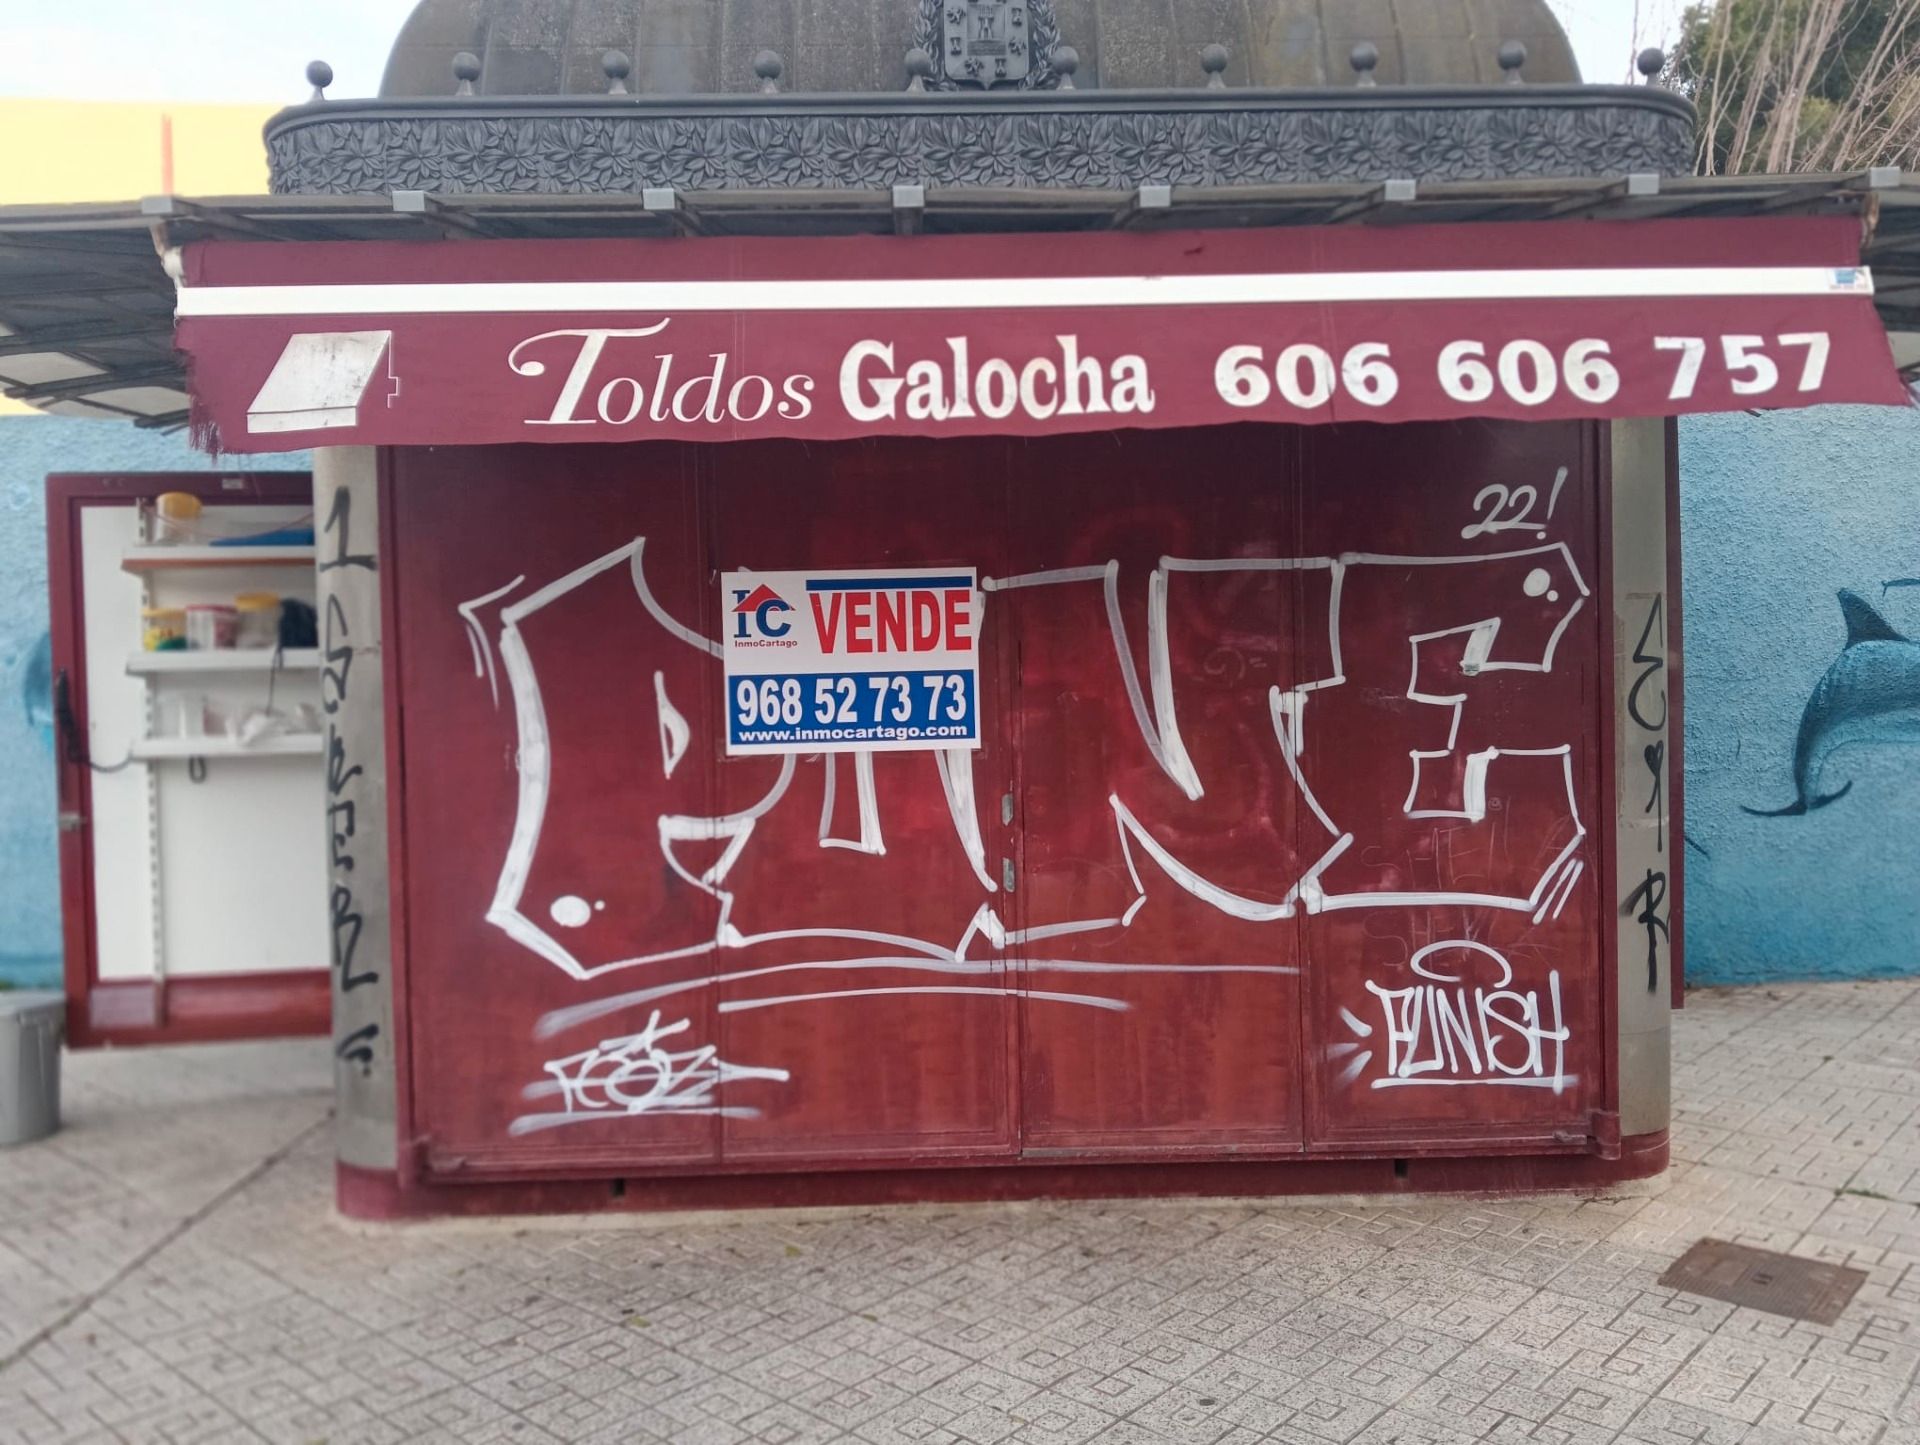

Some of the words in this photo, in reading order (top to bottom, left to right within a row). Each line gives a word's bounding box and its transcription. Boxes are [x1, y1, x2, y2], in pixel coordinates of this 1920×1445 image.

[508, 317, 815, 425] Toldos
[839, 334, 1156, 422] Galocha
[1213, 341, 1399, 409] 606
[1437, 337, 1620, 404] 606
[1653, 331, 1830, 400] 757
[734, 639, 798, 649] InmoCartago
[809, 589, 973, 654] VENDE
[736, 678, 803, 726] 968
[814, 677, 858, 724] 52
[868, 675, 912, 722] 73
[922, 674, 967, 721] 73
[738, 726, 968, 741] www.inmocartago.com
[1364, 969, 1571, 1096] PUNISH
